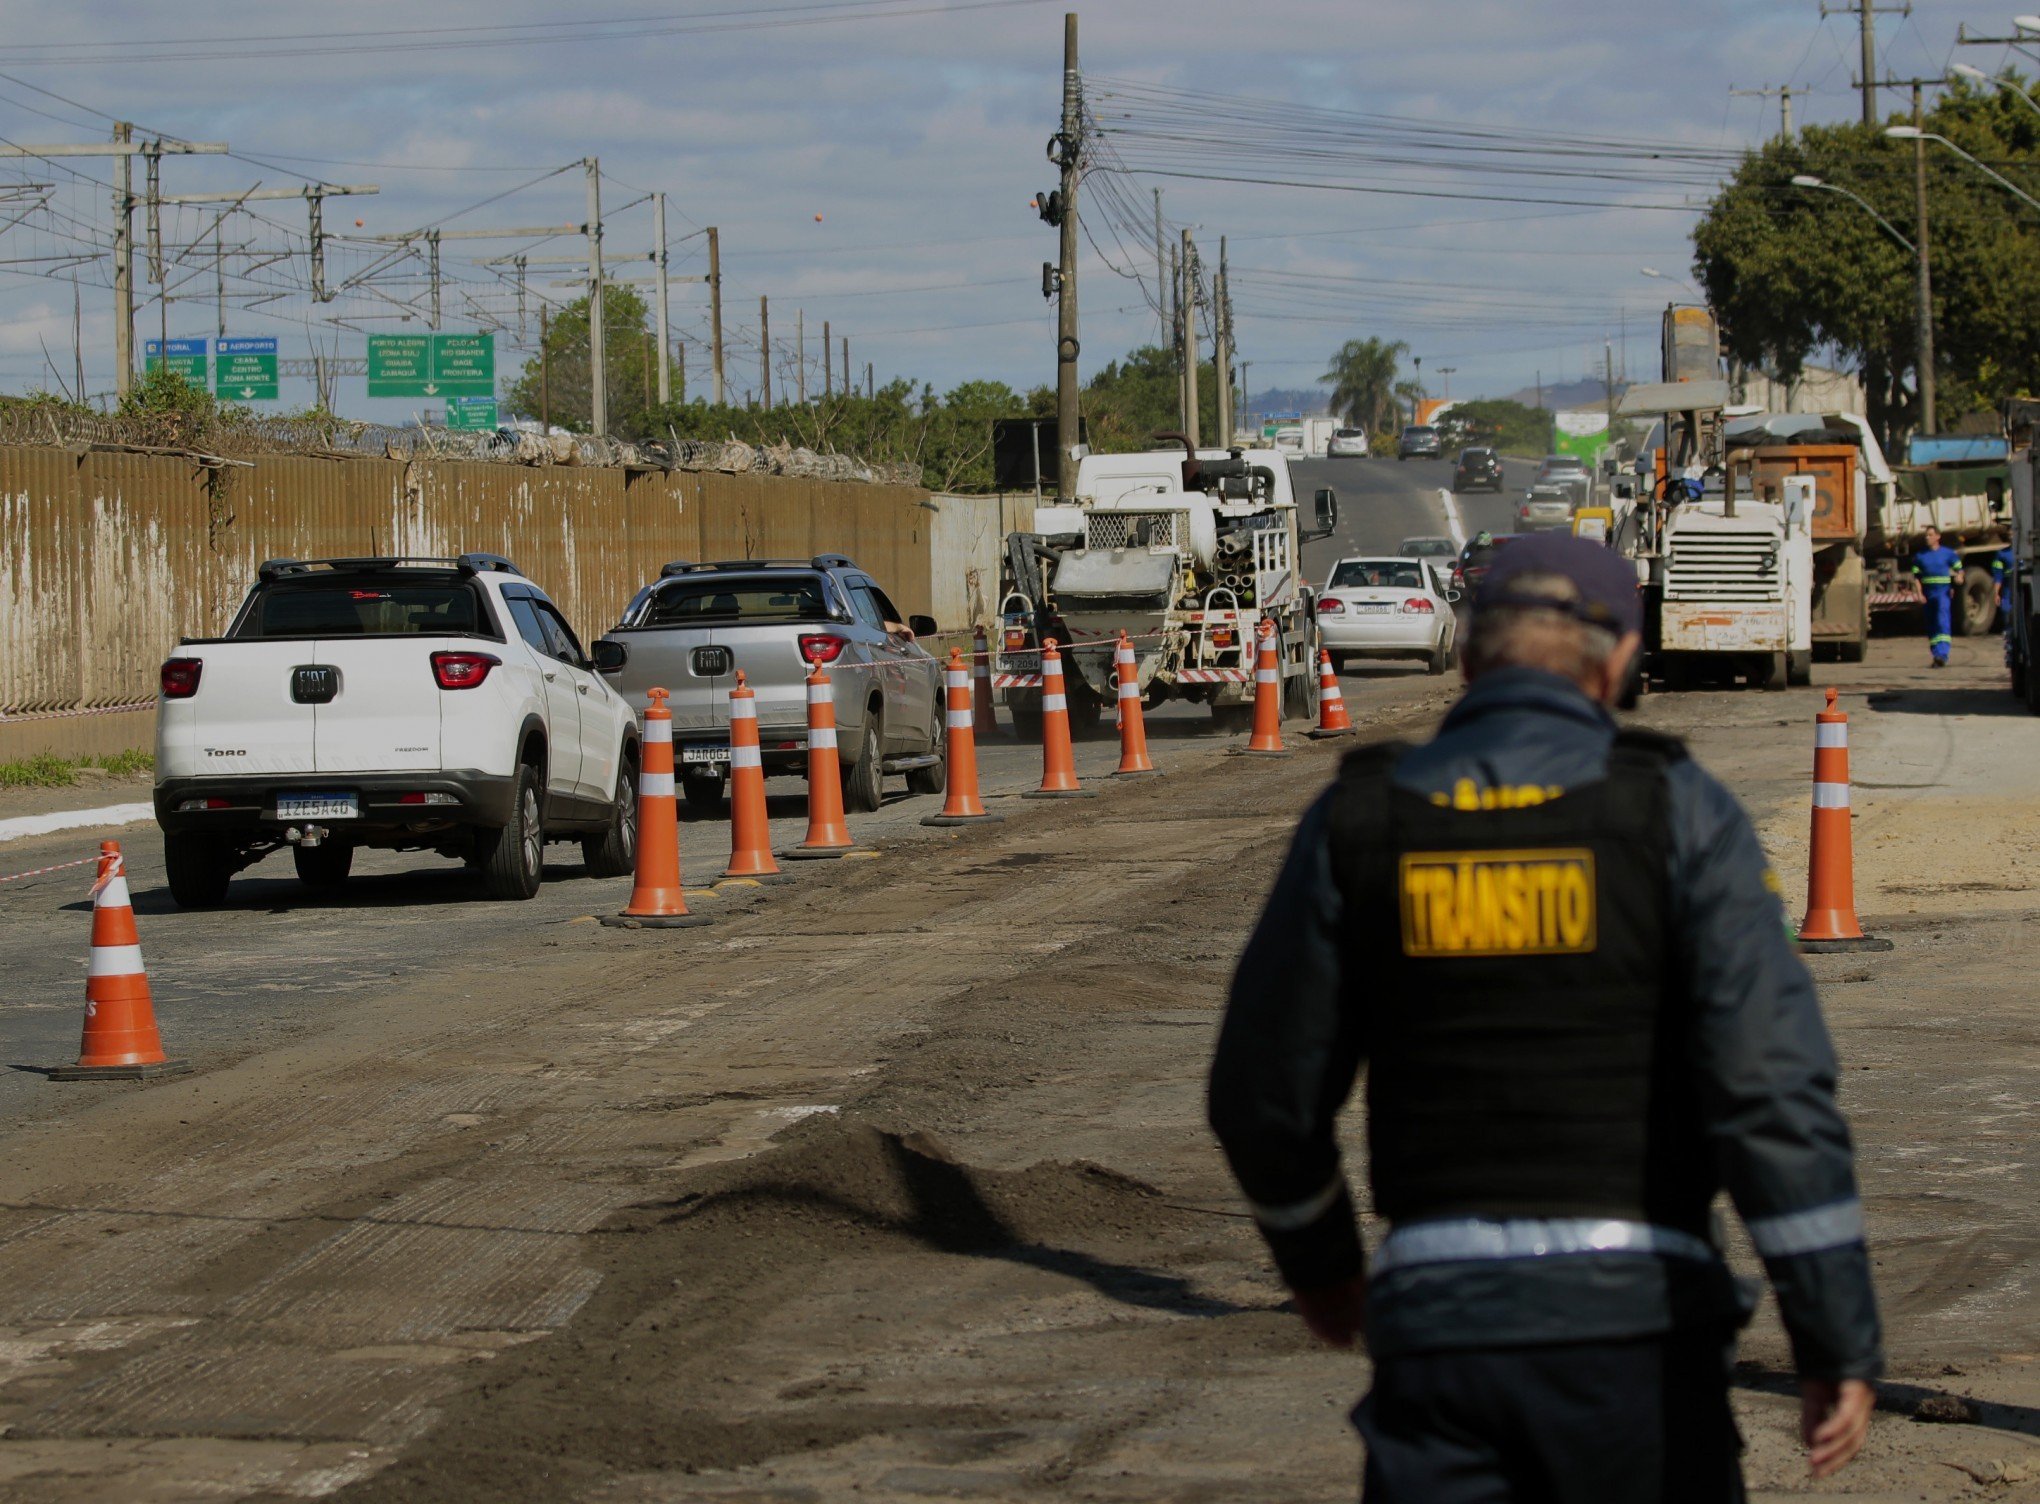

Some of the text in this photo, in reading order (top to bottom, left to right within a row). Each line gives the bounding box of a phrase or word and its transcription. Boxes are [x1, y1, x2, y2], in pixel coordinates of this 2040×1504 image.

[230, 342, 275, 350] AEROPORTO
[700, 650, 721, 668] FIAT
[299, 670, 327, 693] FIAT
[204, 747, 247, 757] TORO
